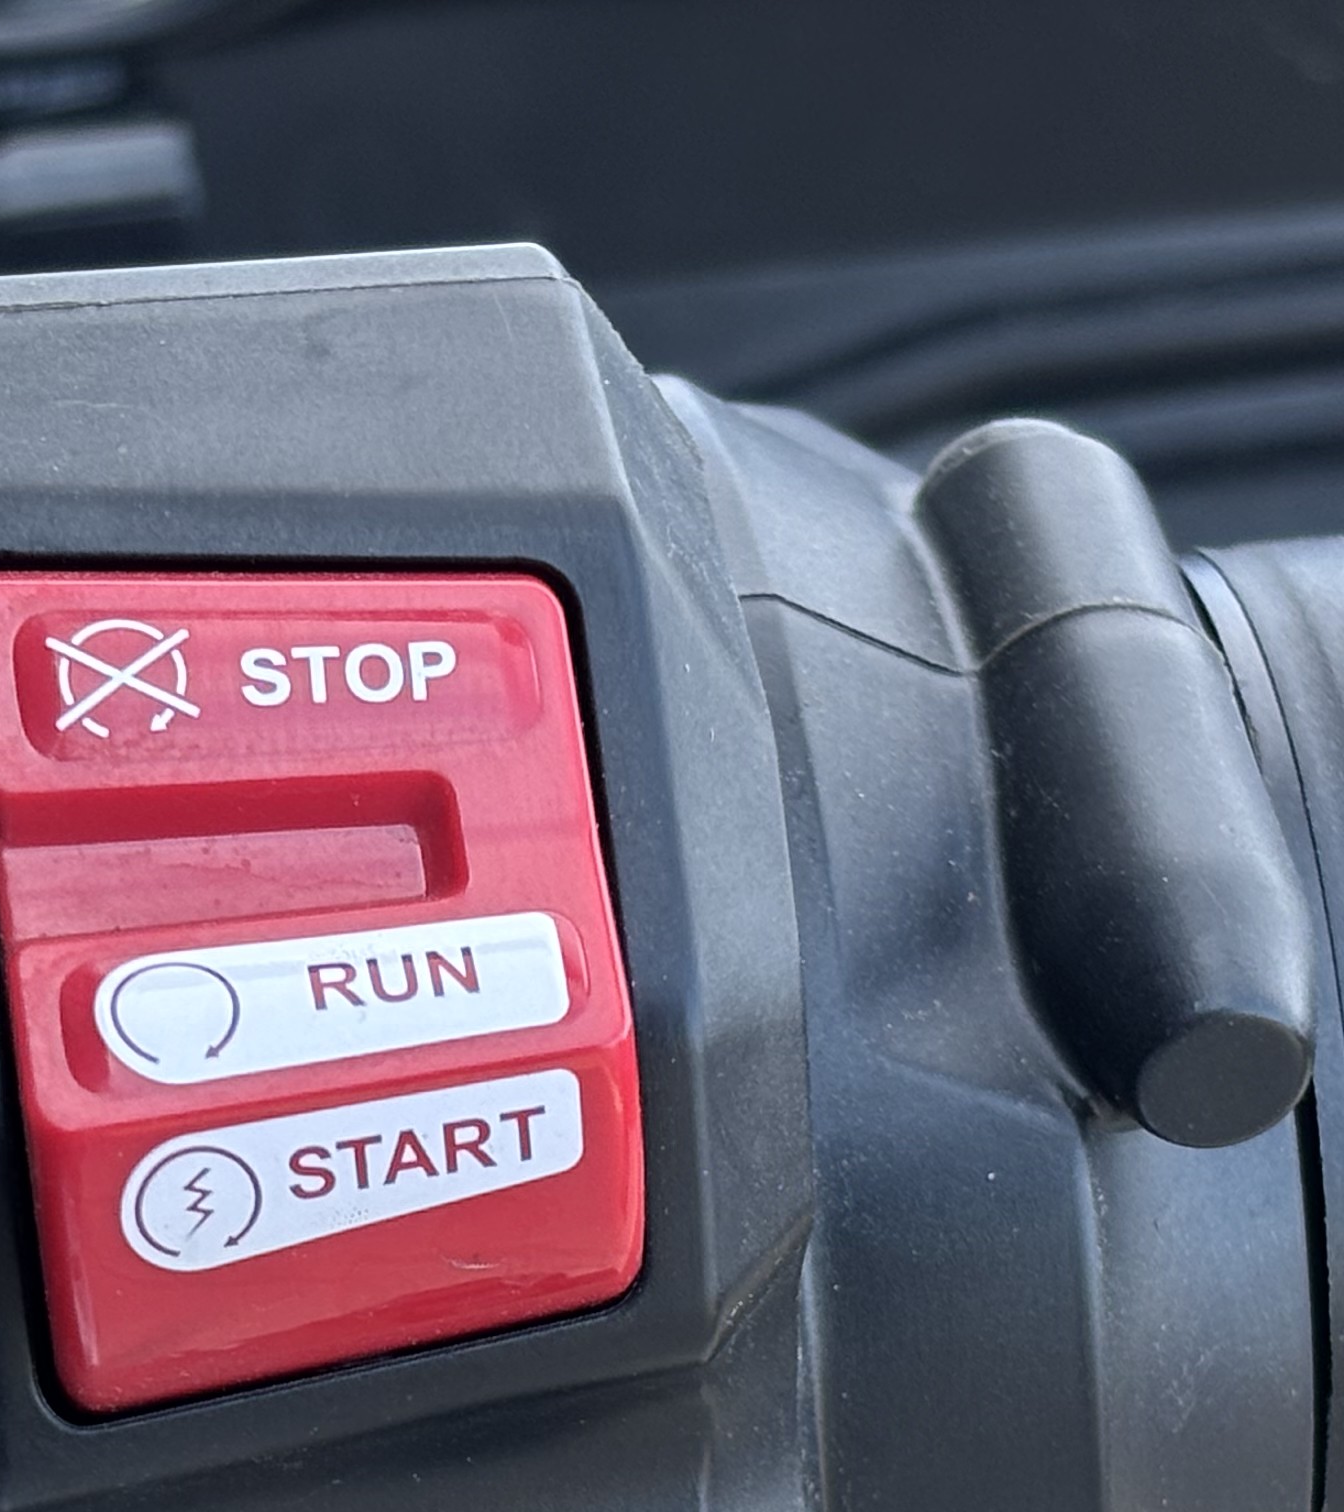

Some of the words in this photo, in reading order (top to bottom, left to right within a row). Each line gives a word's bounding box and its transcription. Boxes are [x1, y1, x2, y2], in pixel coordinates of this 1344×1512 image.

[240, 639, 458, 708] STOP
[307, 945, 482, 1011] RUN
[287, 1104, 546, 1201] START
